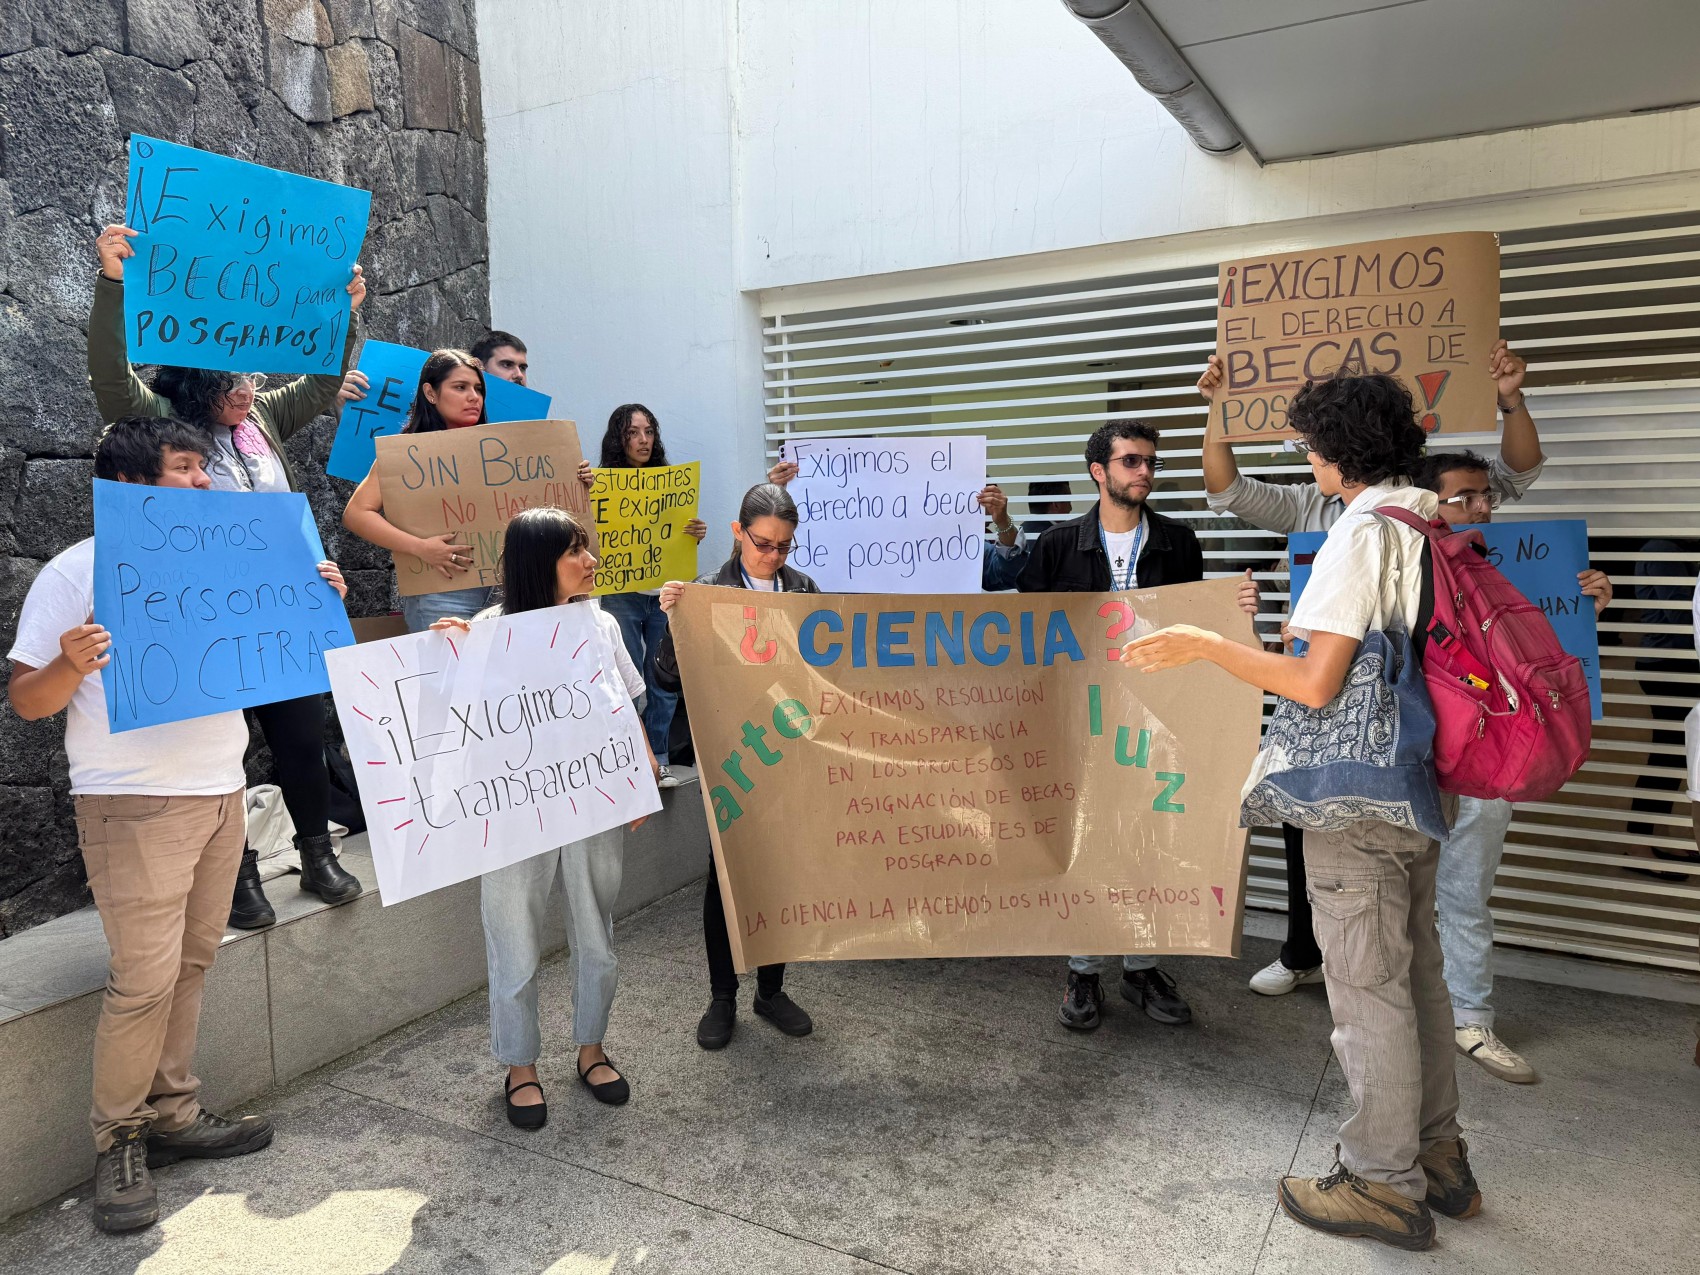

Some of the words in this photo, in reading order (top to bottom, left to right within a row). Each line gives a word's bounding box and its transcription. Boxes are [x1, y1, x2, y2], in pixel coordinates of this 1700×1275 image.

[147, 244, 281, 307] BECAS
[291, 285, 337, 319] para
[1221, 246, 1445, 309] ¡EXIGIMOS
[1226, 317, 1266, 342] EL
[1282, 301, 1425, 337] DERECHO
[1437, 298, 1456, 323] A
[1227, 332, 1402, 389] BECAS
[1428, 333, 1466, 362] DE
[1220, 395, 1289, 435] POS
[402, 444, 460, 490] SIN
[794, 443, 909, 488] Exigimos
[931, 442, 951, 471] el
[620, 488, 696, 525] exigimos
[797, 487, 884, 524] derecho
[892, 495, 908, 519] a
[923, 481, 982, 516] beca
[140, 496, 268, 553] Somos
[660, 523, 672, 540] a
[643, 543, 662, 564] de
[793, 529, 828, 567] de
[848, 524, 980, 579] posgrado
[117, 563, 323, 627] Personas
[594, 564, 661, 592] osgrado
[114, 643, 179, 722] NO
[820, 688, 925, 716] EXIGIMOS
[936, 680, 1044, 707] RESOLUCIÓN
[840, 731, 854, 747] Y
[869, 720, 1029, 749] TRANSPARENCIA
[828, 763, 854, 785] EN
[872, 760, 907, 779] LOS
[917, 754, 1015, 776] PROCESOS
[1024, 750, 1048, 769] DE
[846, 788, 976, 816] ASIGNACIÓN
[985, 789, 1011, 804] DE
[1021, 782, 1076, 803] BECAS
[836, 829, 886, 847] PARA
[898, 821, 1026, 846] ESTUDIANTES
[1034, 817, 1058, 836] DE
[886, 853, 993, 872] POSGRADO
[746, 911, 768, 936] LA
[780, 898, 858, 926] CIENCIA
[870, 898, 895, 921] LA
[907, 894, 992, 916] HACEMOS
[999, 893, 1031, 910] LOS
[1039, 890, 1096, 920] HIJOS
